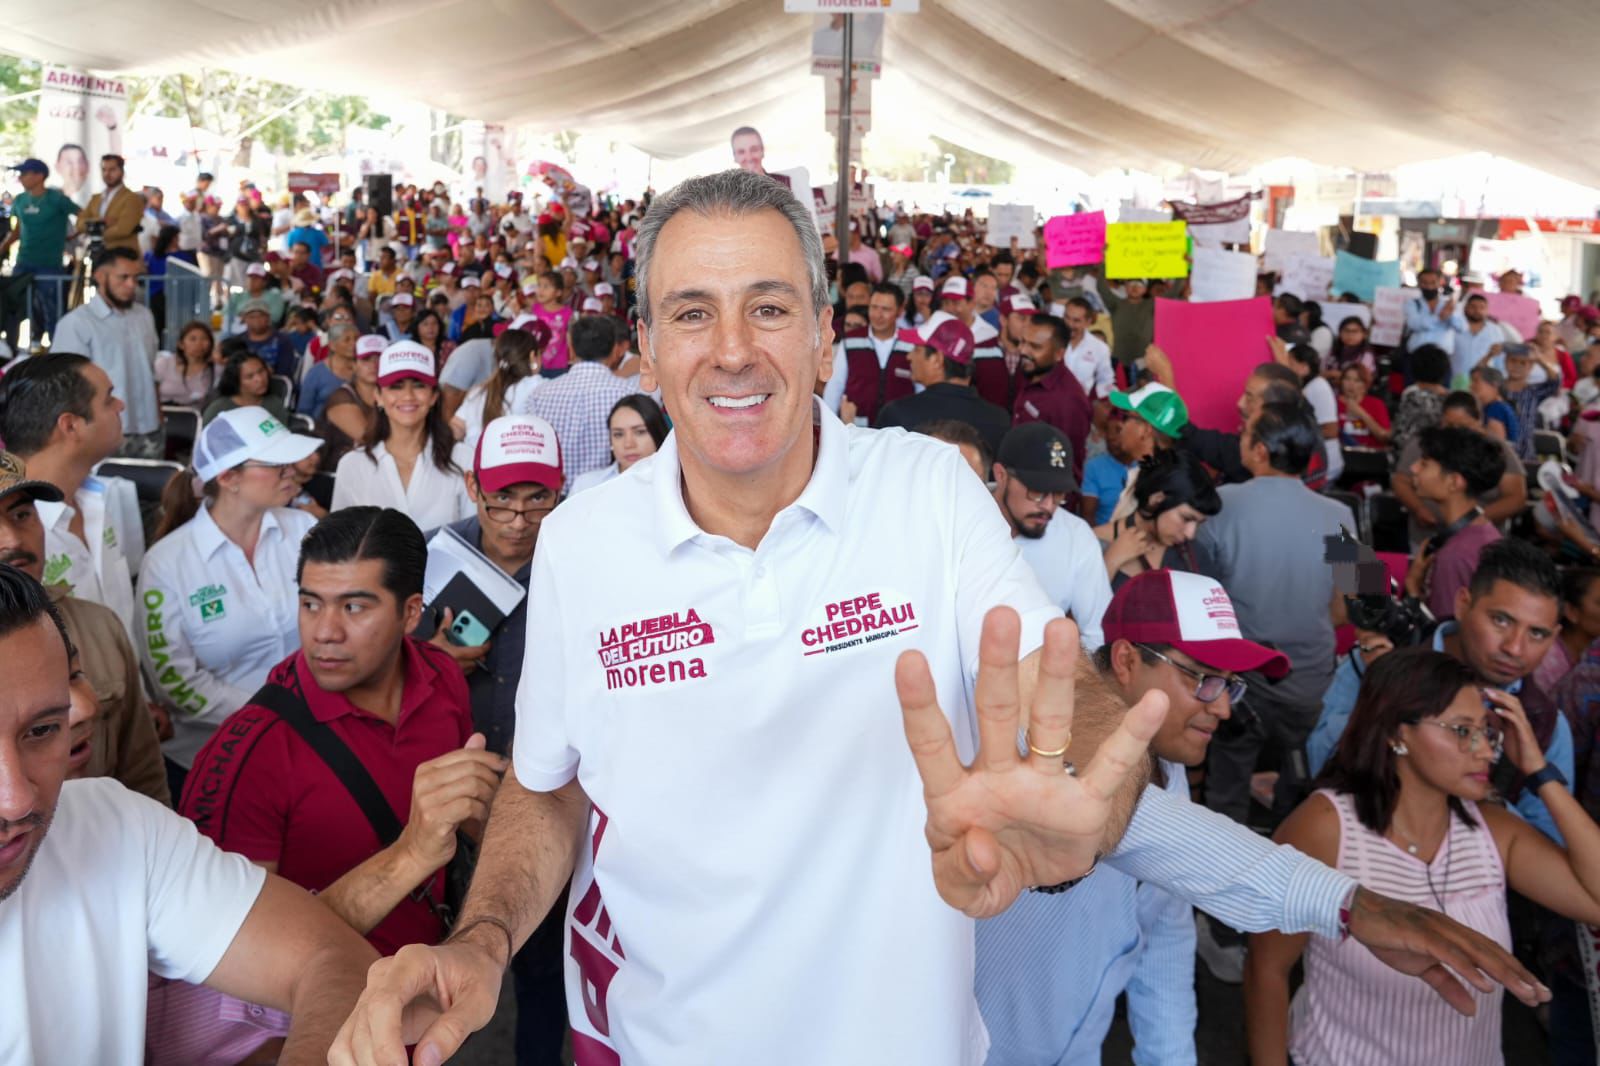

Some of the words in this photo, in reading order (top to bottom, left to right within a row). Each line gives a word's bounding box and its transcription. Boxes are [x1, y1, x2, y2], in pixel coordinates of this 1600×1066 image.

[47, 71, 125, 94] ARMENTA
[511, 423, 534, 431] PEPE
[801, 602, 916, 647] CHEDRAUI
[825, 592, 882, 622] PEPE
[600, 627, 619, 648] LA
[621, 608, 702, 643] PUEBLA
[825, 637, 864, 654] PRESIDENTE
[865, 629, 899, 644] MUNICIPAL
[143, 589, 209, 716] CHAVERO
[601, 646, 629, 667] DEL
[628, 628, 705, 661] FUTURO
[606, 657, 708, 690] morena
[192, 713, 264, 830] MICHAEL
